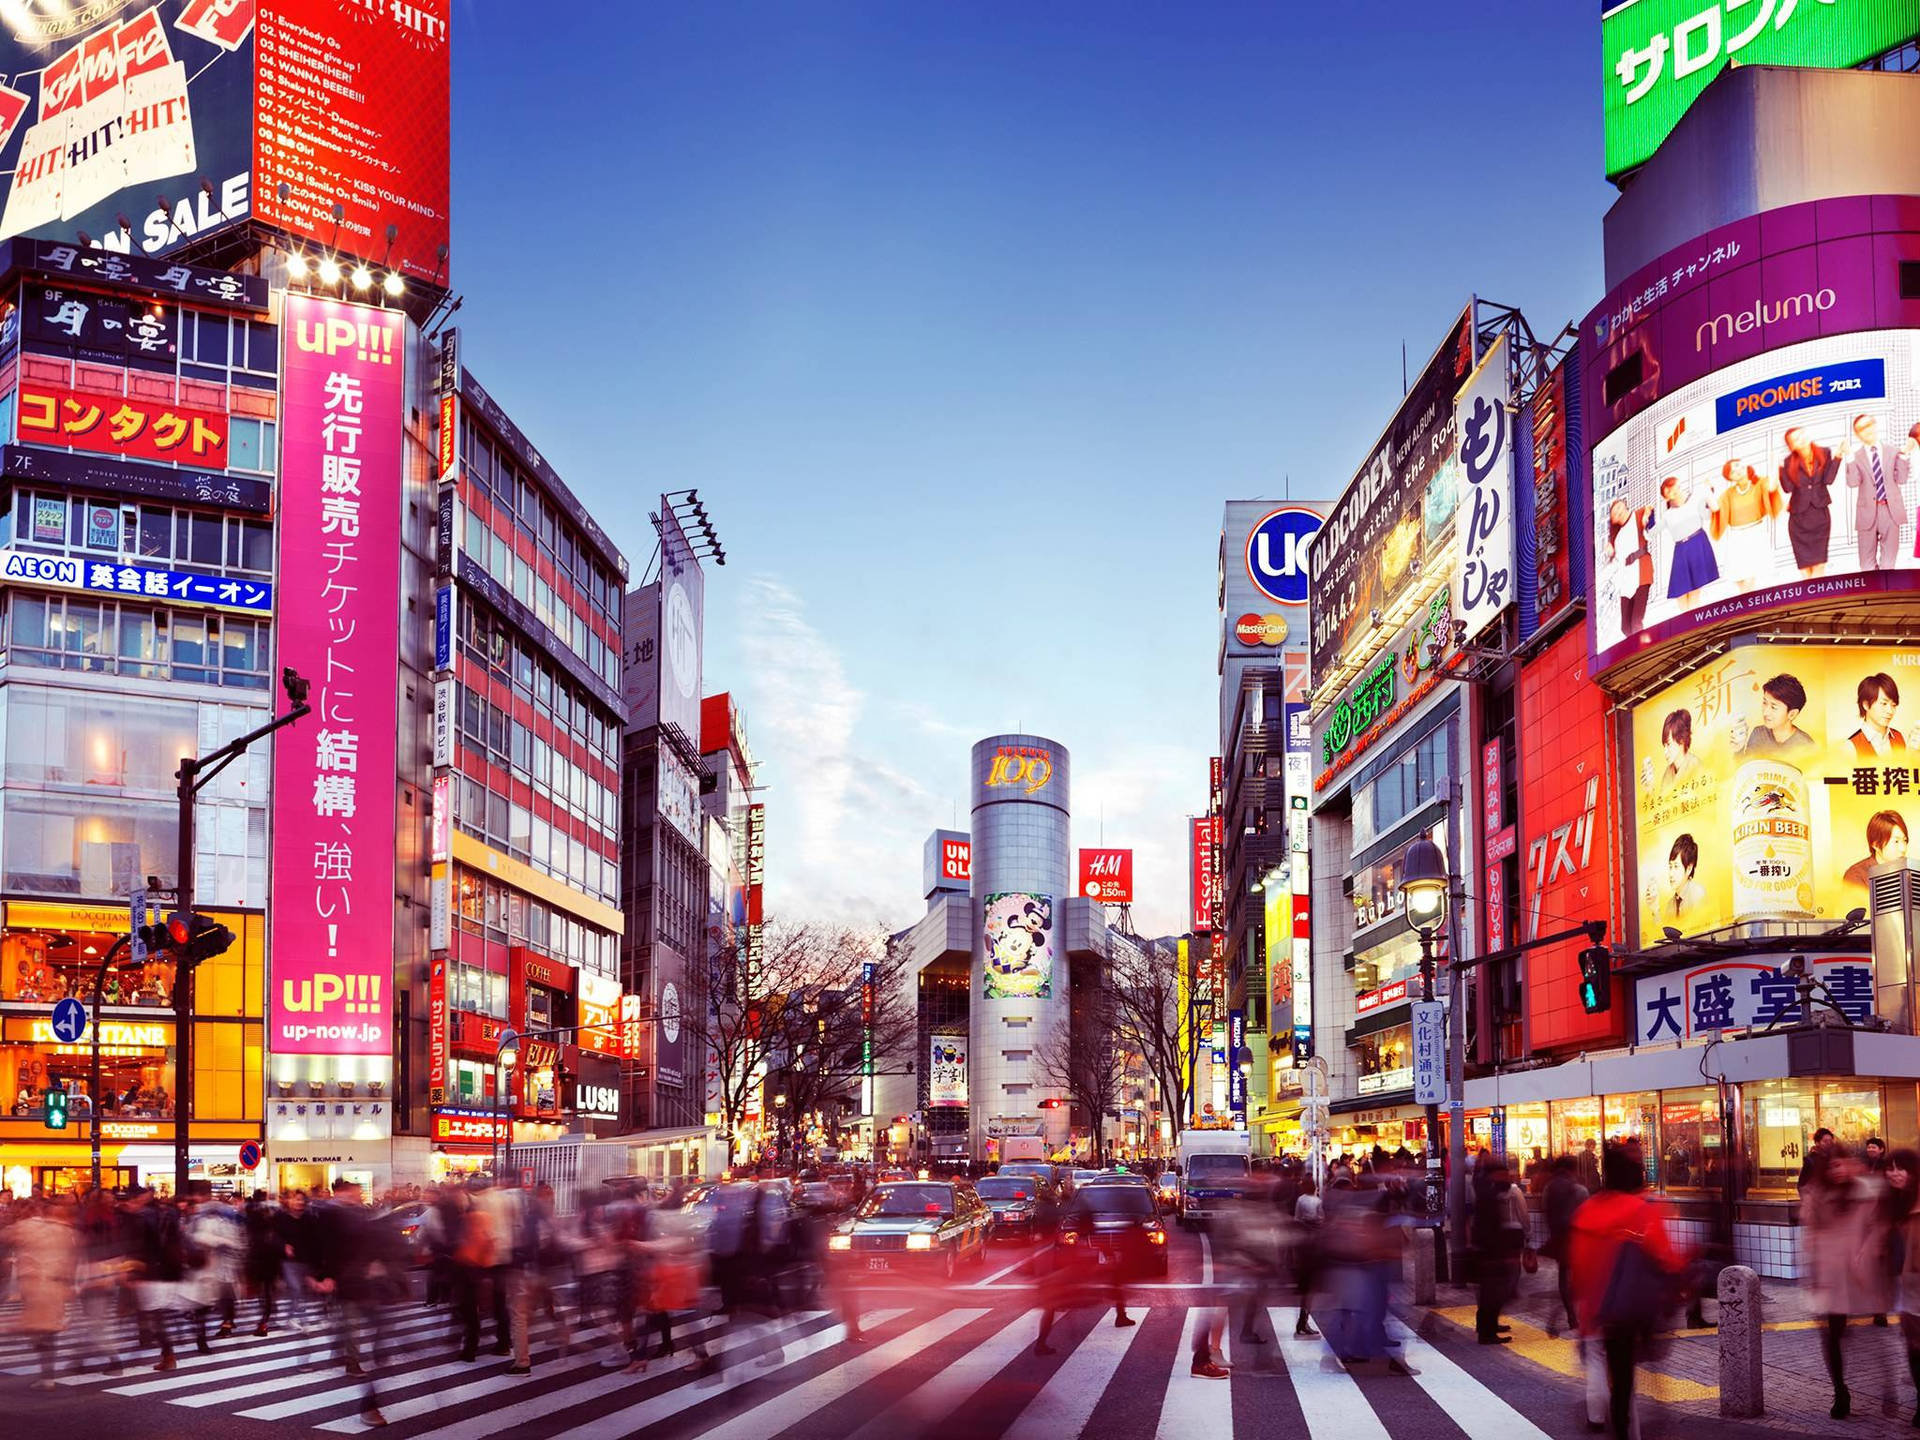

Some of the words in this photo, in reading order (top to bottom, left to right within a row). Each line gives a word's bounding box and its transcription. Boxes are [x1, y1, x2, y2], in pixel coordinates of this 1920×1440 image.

[260, 9, 277, 23] 01.
[278, 15, 325, 45] Everybody
[327, 37, 341, 50] Go
[390, 0, 445, 42] HIT!
[260, 23, 277, 38] 02.
[279, 30, 295, 45] We
[297, 41, 322, 56] never
[324, 52, 342, 65] give
[260, 38, 277, 53] 03.
[260, 53, 277, 67] 04.
[278, 60, 321, 84] WANNA
[260, 68, 277, 82] 05.
[278, 75, 305, 94] Shake
[317, 91, 330, 105] Up
[259, 97, 276, 112] 07.
[68, 117, 125, 167] HIT!
[125, 95, 188, 135] HIT!
[258, 112, 276, 127] 08.
[277, 120, 293, 135] My
[295, 126, 342, 153] Resistance
[259, 158, 275, 172] 11.
[336, 187, 350, 201] On
[259, 173, 275, 187] 12.
[259, 187, 275, 202] 13.
[260, 143, 275, 157] 10.
[354, 179, 376, 195] KISS
[378, 187, 406, 207] YOUR
[408, 201, 435, 219] MIND
[142, 171, 249, 254] SALE
[258, 202, 275, 215] 14.
[44, 290, 63, 301] 9F
[1610, 277, 1668, 330] わかさ生活
[1672, 241, 1741, 287] チャンネル
[1696, 288, 1836, 352] melumo
[296, 318, 393, 365] uP!!!
[1736, 376, 1823, 417] PROMISE
[1829, 378, 1861, 393] プロミス
[21, 393, 221, 453] コンタクト
[14, 455, 32, 469] 7F
[1313, 438, 1393, 583] OLDCODEX
[1396, 443, 1411, 466] NEW
[1412, 402, 1436, 451] ALBUM
[1362, 488, 1401, 545] within
[1404, 457, 1425, 491] the
[1460, 396, 1508, 611] もんじゃ
[6, 555, 76, 583] AEON
[90, 563, 266, 604] 英会話イーオン
[1314, 582, 1357, 654] 2014.4.2
[1694, 600, 1744, 623] WAKASA
[1748, 586, 1802, 607] SEIKATSU
[1807, 577, 1867, 595] CHANNEL
[1236, 623, 1288, 634] MasterCard
[434, 776, 448, 788] 5F
[984, 754, 1053, 794] 109
[1735, 821, 1771, 842] KIRIN
[1775, 822, 1806, 838] BEER
[1089, 855, 1123, 877] H&M
[1196, 822, 1211, 928] Essential
[1528, 774, 1599, 942] クスリ
[1749, 865, 1791, 876] 一番搾り
[1102, 888, 1126, 897] 150m
[526, 962, 551, 983] COFFEE
[282, 973, 382, 1015] uP!!!
[1646, 965, 1875, 1041] 大盛堂書
[282, 1023, 382, 1043] up-now.jp
[594, 1035, 604, 1049] 3F
[1417, 1010, 1433, 1088] 文化村通り
[933, 1066, 964, 1083] 学割
[576, 1085, 619, 1113] LUSH
